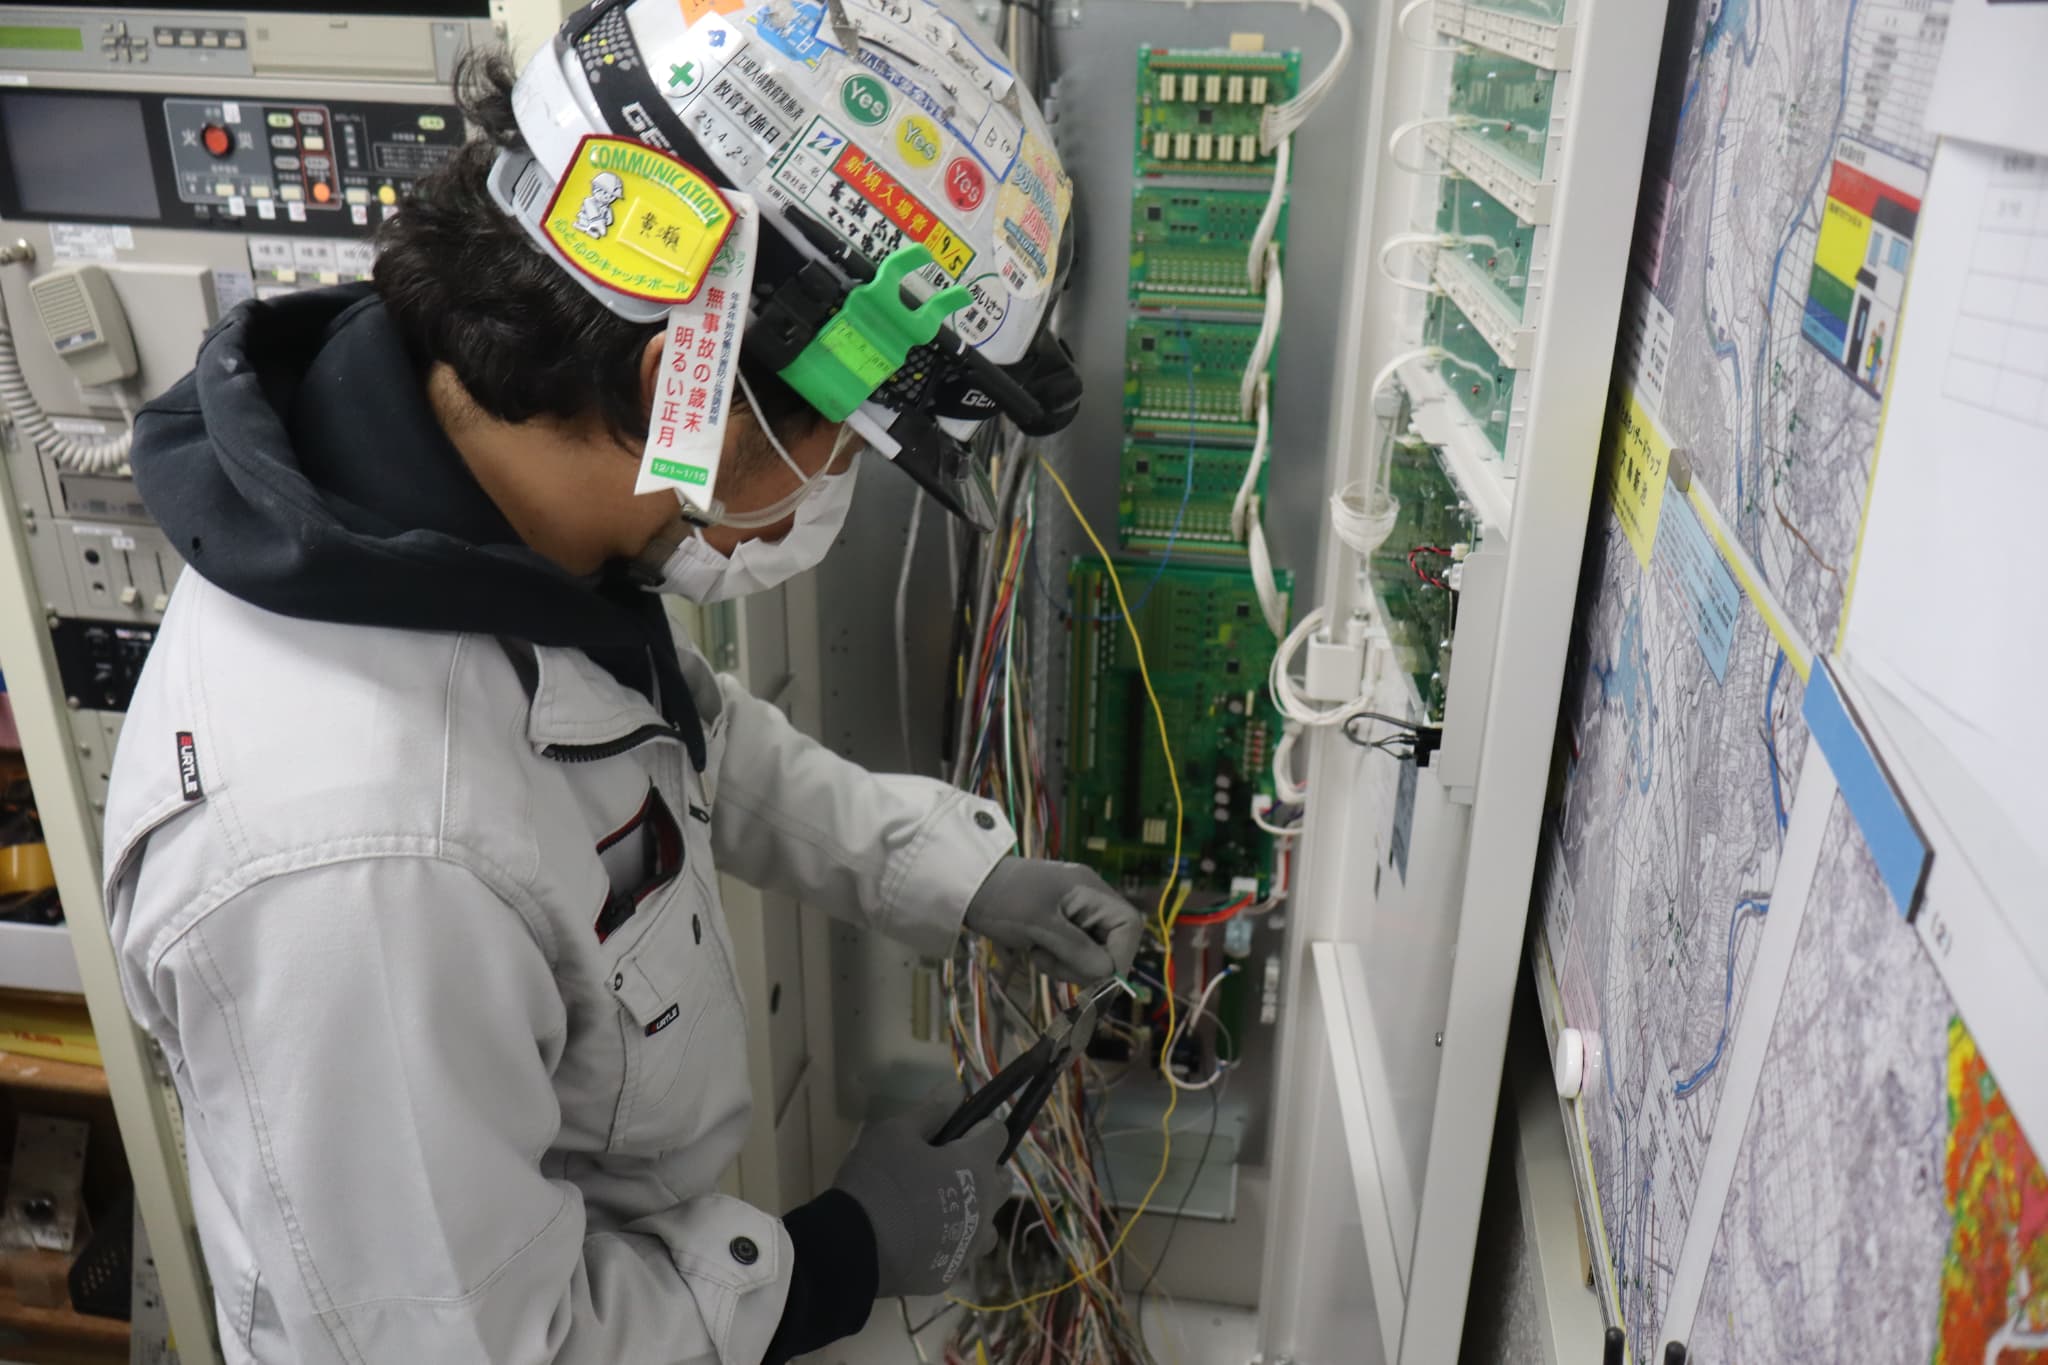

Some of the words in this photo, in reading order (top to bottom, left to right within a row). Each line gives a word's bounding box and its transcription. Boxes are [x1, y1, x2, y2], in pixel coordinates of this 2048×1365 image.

[712, 79, 780, 144] 教育実施日
[851, 81, 886, 117] Yes
[903, 119, 937, 161] Yes
[589, 144, 725, 228] COMMUNICATION
[844, 155, 930, 234] 新規入場者
[953, 164, 980, 203] Yes
[656, 325, 694, 448] 明るい正月
[682, 286, 726, 433] 無事故の歳末
